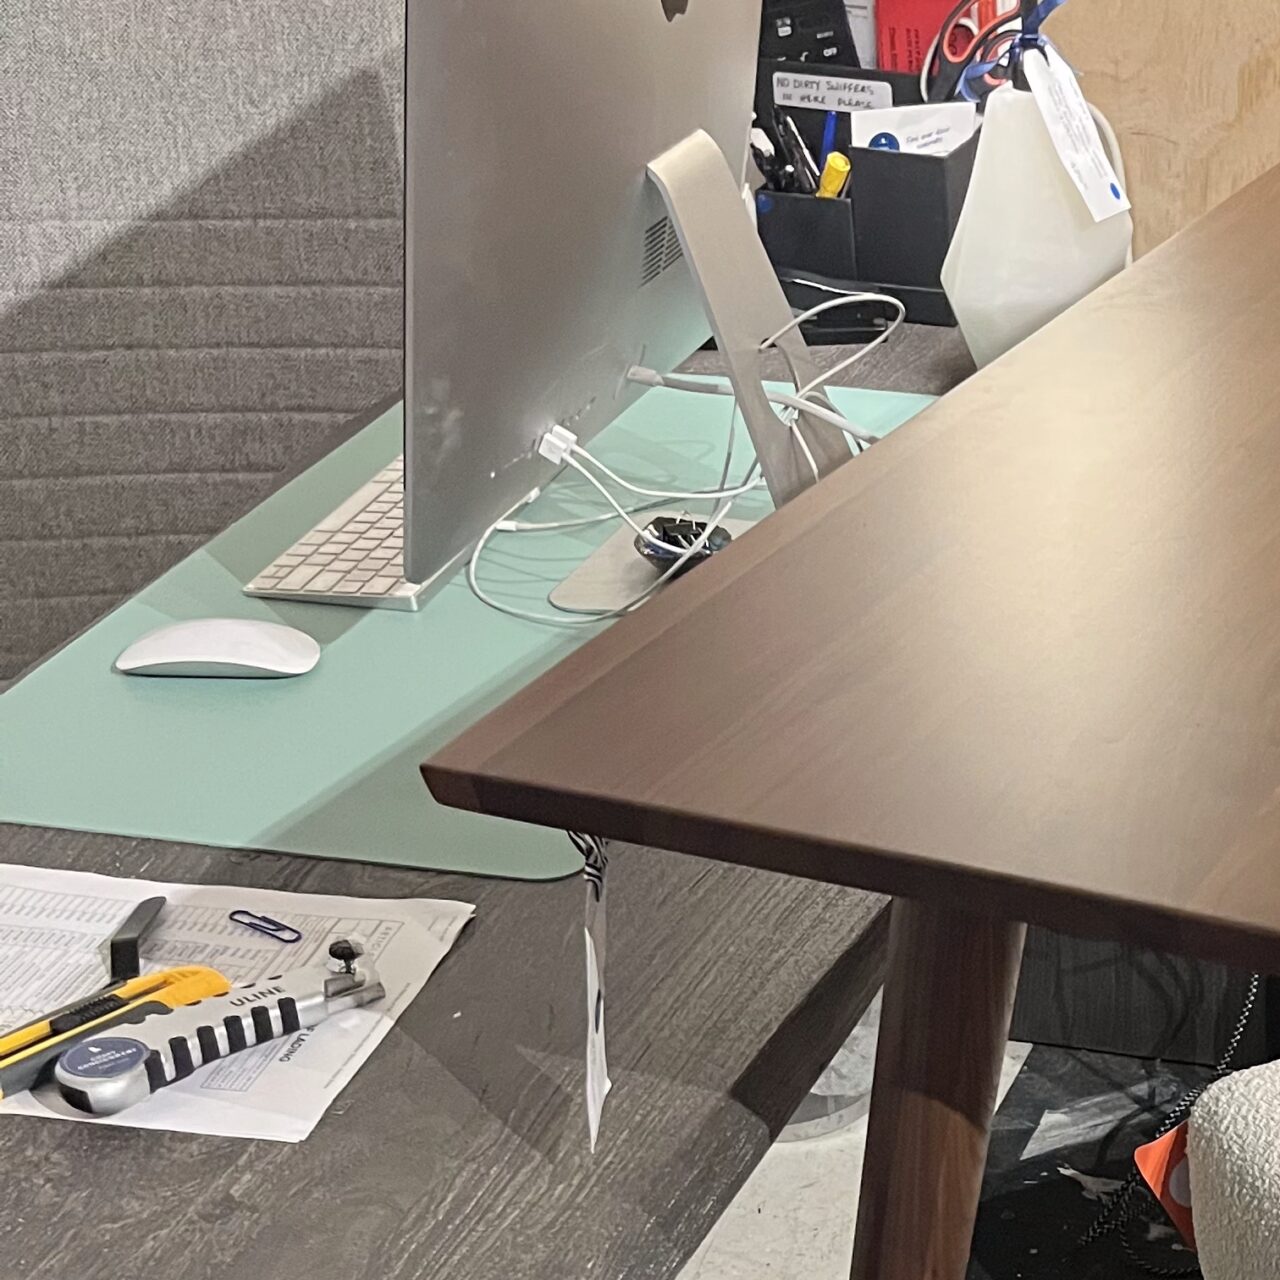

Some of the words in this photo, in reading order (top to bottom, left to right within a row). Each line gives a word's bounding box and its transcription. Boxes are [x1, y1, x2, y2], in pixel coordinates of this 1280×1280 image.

[776, 77, 789, 88] NO
[793, 79, 820, 91] DIRTY
[229, 986, 285, 1007] ULINE
[278, 1033, 310, 1062] LADING
